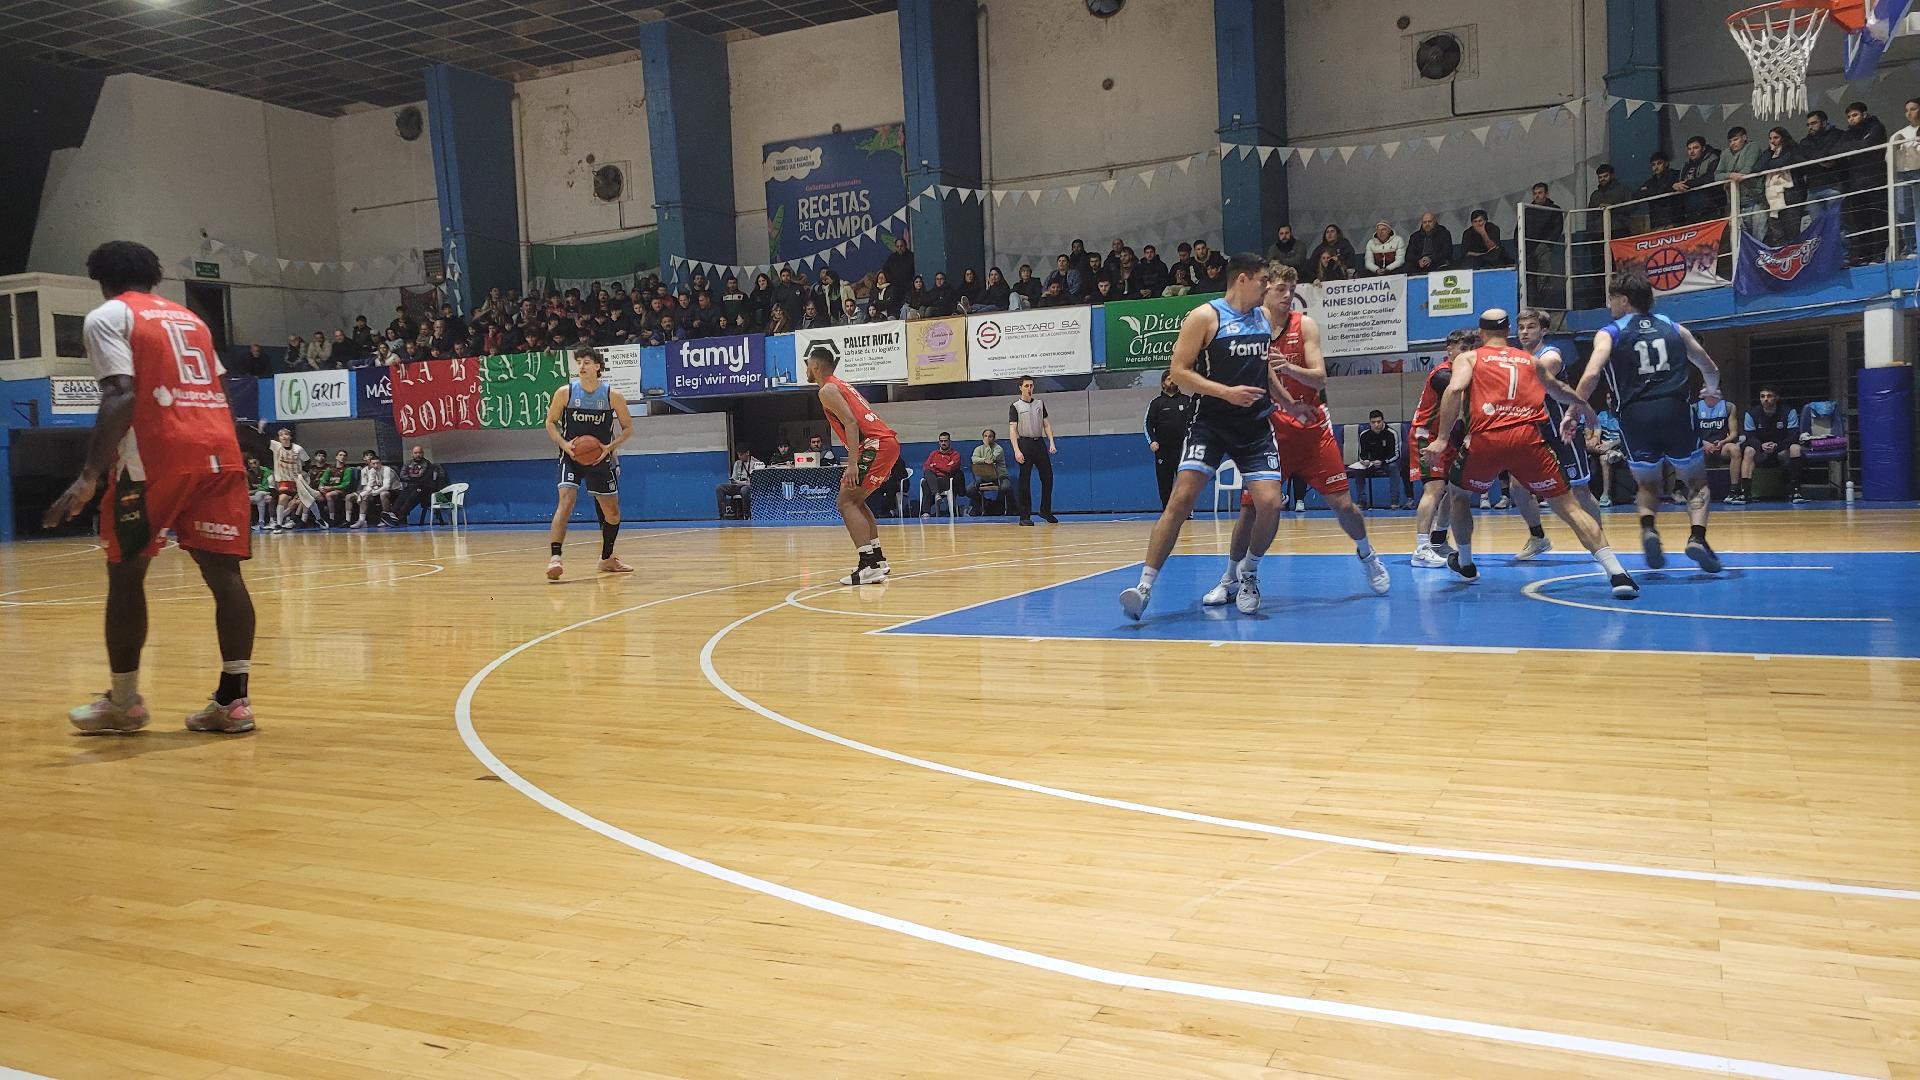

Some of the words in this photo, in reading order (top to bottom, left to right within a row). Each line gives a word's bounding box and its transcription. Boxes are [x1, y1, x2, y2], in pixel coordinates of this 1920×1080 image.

[798, 189, 871, 220] RECETAS
[799, 221, 813, 232] DEL
[814, 213, 873, 241] CAMPO
[1636, 231, 1697, 250] RUNUP
[1326, 280, 1391, 295] OSTEOPATÍA
[1322, 292, 1397, 307] KINESIOLOGÍA
[1061, 320, 1080, 328] SA
[1340, 320, 1371, 329] Fernando
[843, 335, 871, 349] PALLET
[872, 332, 894, 347] RUTA
[894, 332, 900, 344] 7
[1340, 332, 1371, 340] Bernardo
[161, 319, 212, 385] 15
[680, 336, 750, 373] famyl
[1125, 355, 1152, 363] Mercado
[1633, 338, 1671, 375] 11
[397, 361, 434, 386] LA
[450, 349, 568, 382] BANDA
[675, 374, 702, 390] Elegí
[704, 372, 727, 385] vivir
[729, 370, 762, 387] mejor
[311, 381, 347, 401] GRIT
[469, 381, 491, 395] del
[574, 398, 582, 407] 9
[572, 410, 606, 425] famyl
[1699, 419, 1725, 430] famyl
[1187, 444, 1207, 460] 15
[567, 472, 575, 481] 9
